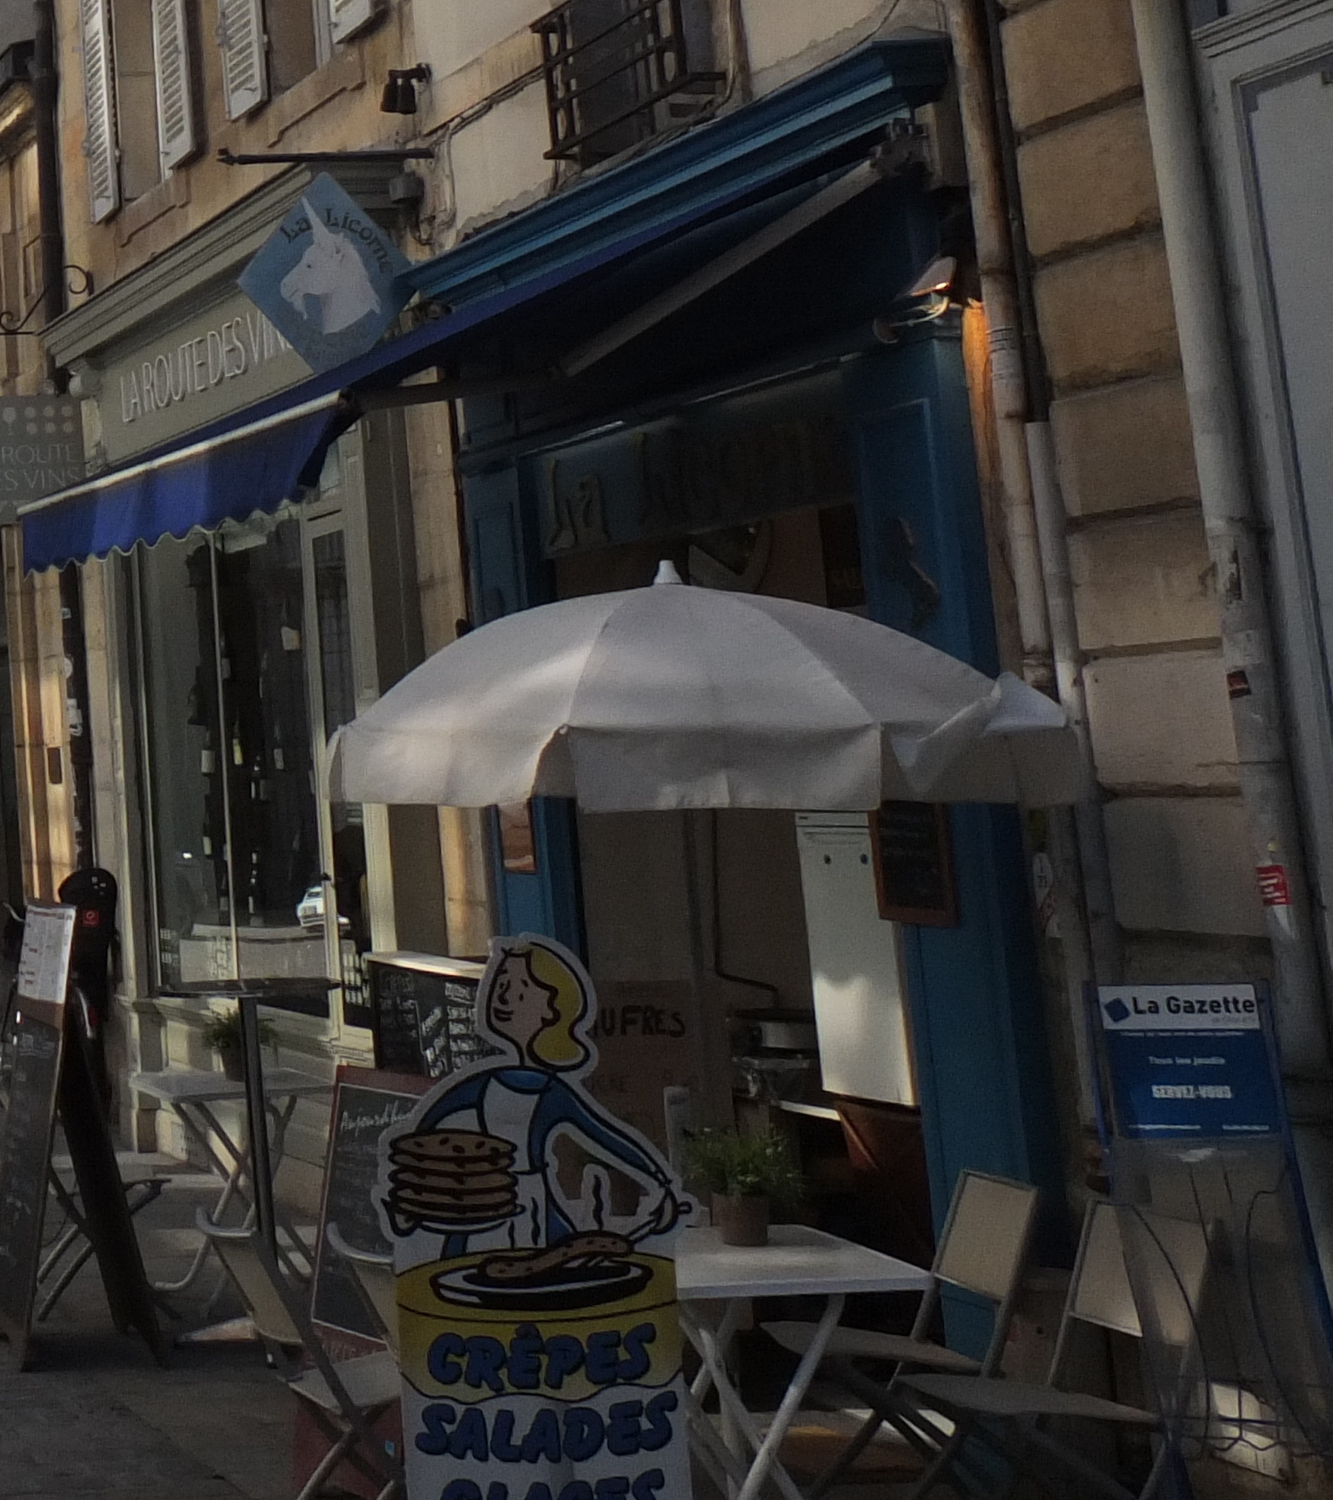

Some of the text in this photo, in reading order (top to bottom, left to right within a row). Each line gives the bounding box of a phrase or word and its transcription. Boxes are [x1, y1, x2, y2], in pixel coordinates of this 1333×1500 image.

[280, 207, 394, 274] La Licorne
[142, 337, 208, 412] ROUTE
[207, 316, 246, 385] DES
[247, 309, 294, 366] VIN
[1, 444, 75, 465] ROUTE
[1132, 996, 1255, 1015] La Gazette
[427, 1322, 657, 1393] CRÊPES
[414, 1390, 679, 1464] SALADES
